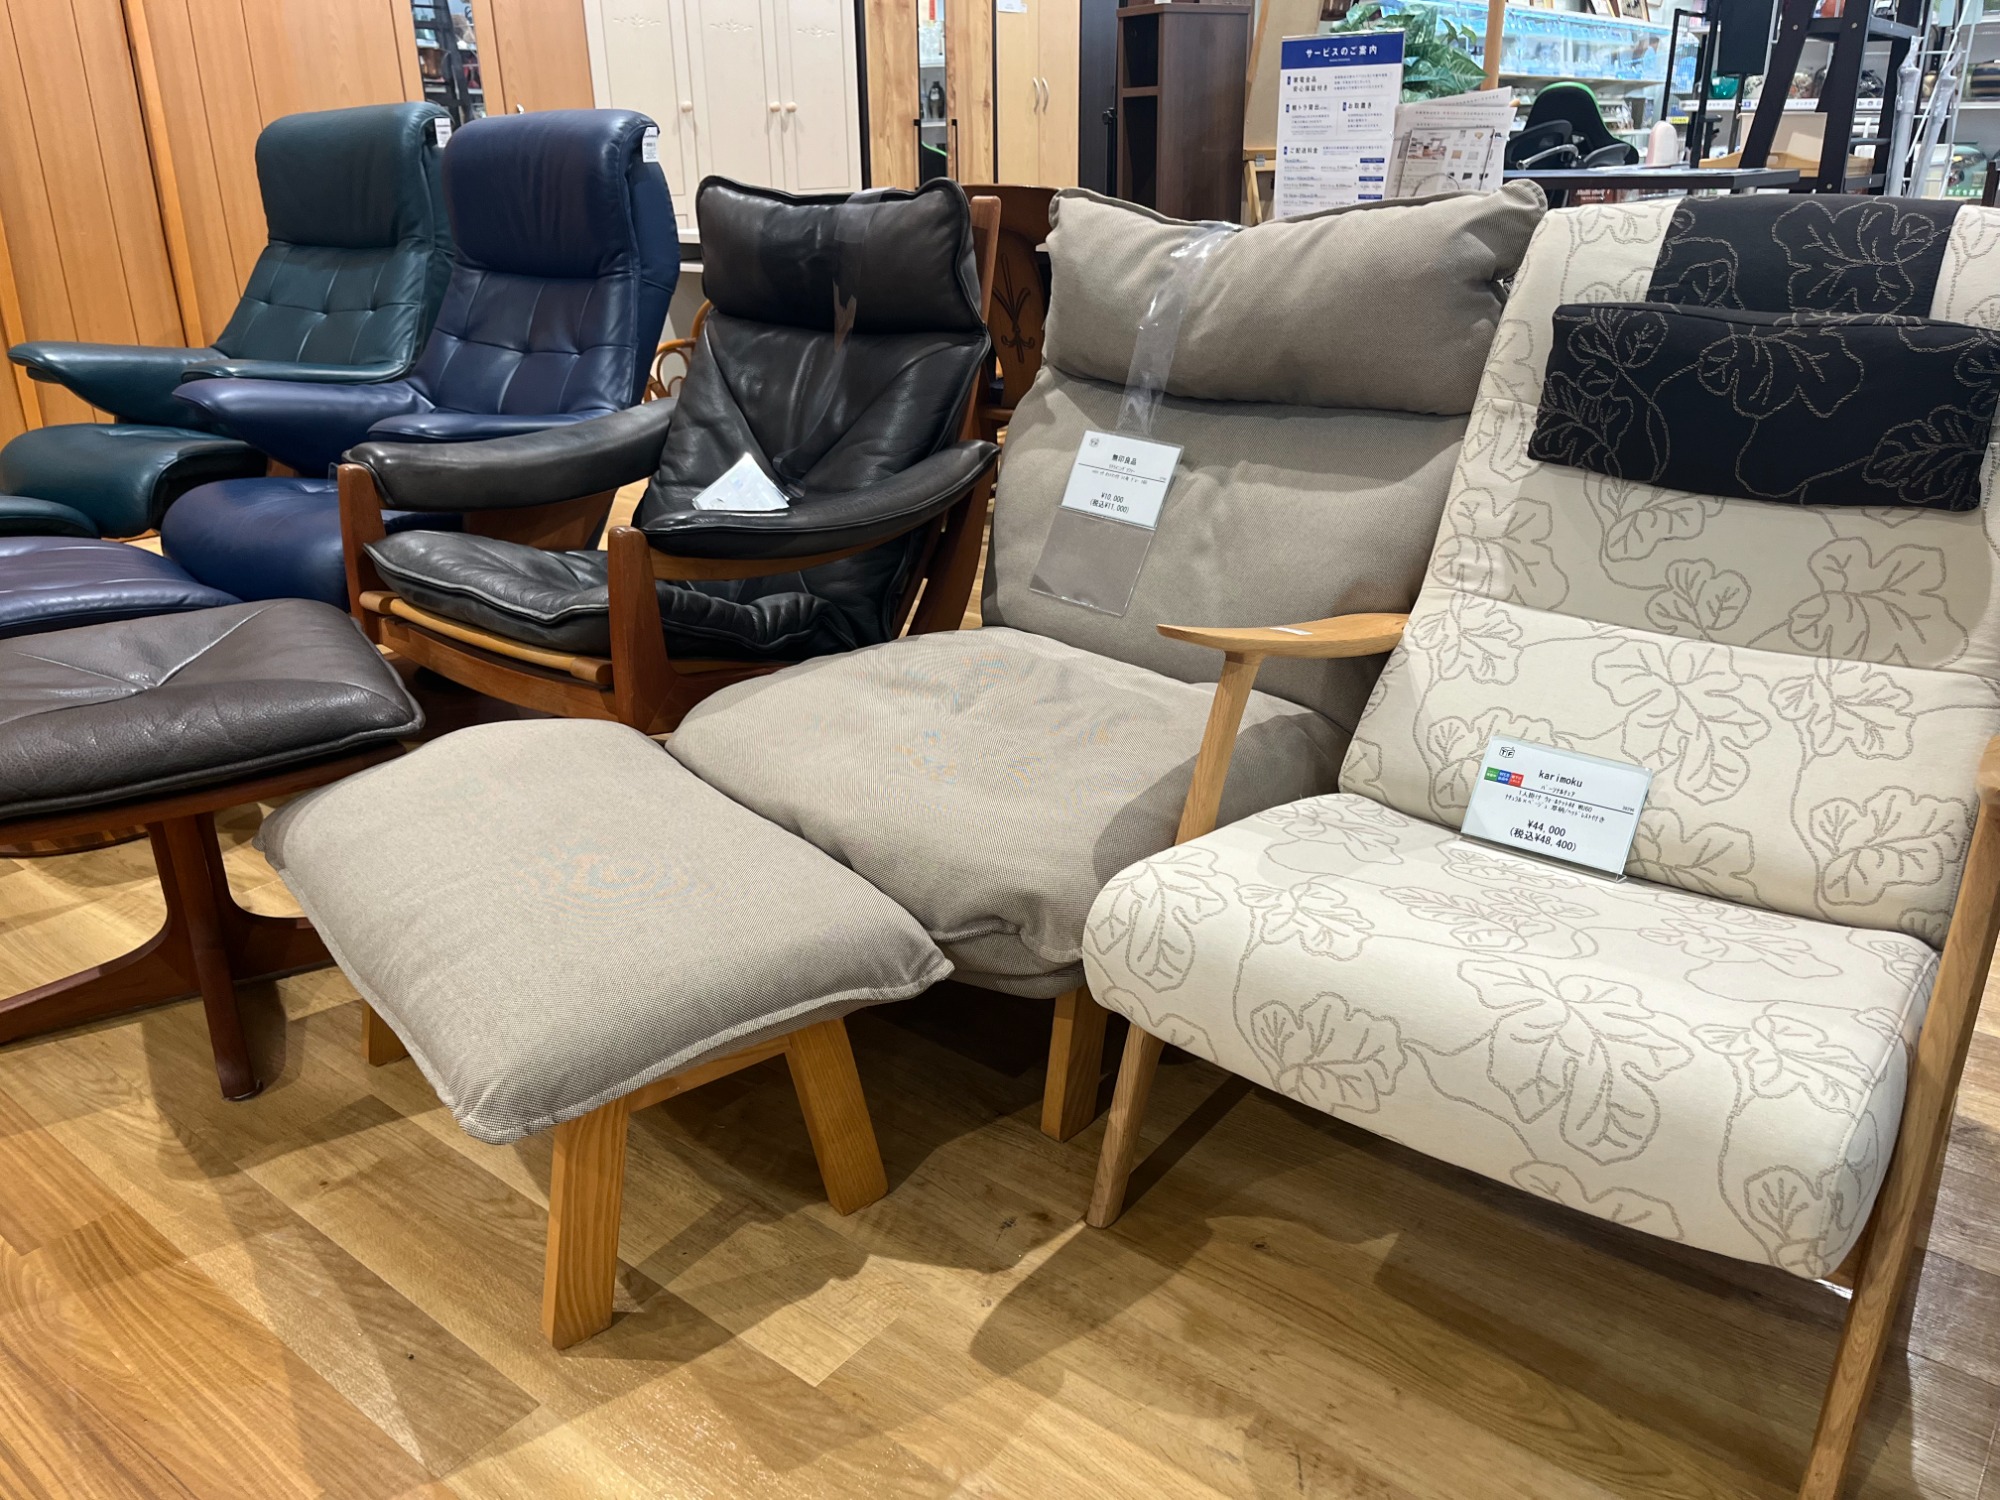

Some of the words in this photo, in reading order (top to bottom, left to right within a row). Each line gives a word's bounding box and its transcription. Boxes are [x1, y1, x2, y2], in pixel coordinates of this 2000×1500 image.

[1305, 45, 1377, 58] サービスのご案内
[1112, 454, 1137, 466] 無印良品
[1538, 770, 1583, 788] karimoku
[1528, 819, 1566, 837] ¥44,000
[1510, 827, 1577, 852] (税込¥48,400)
